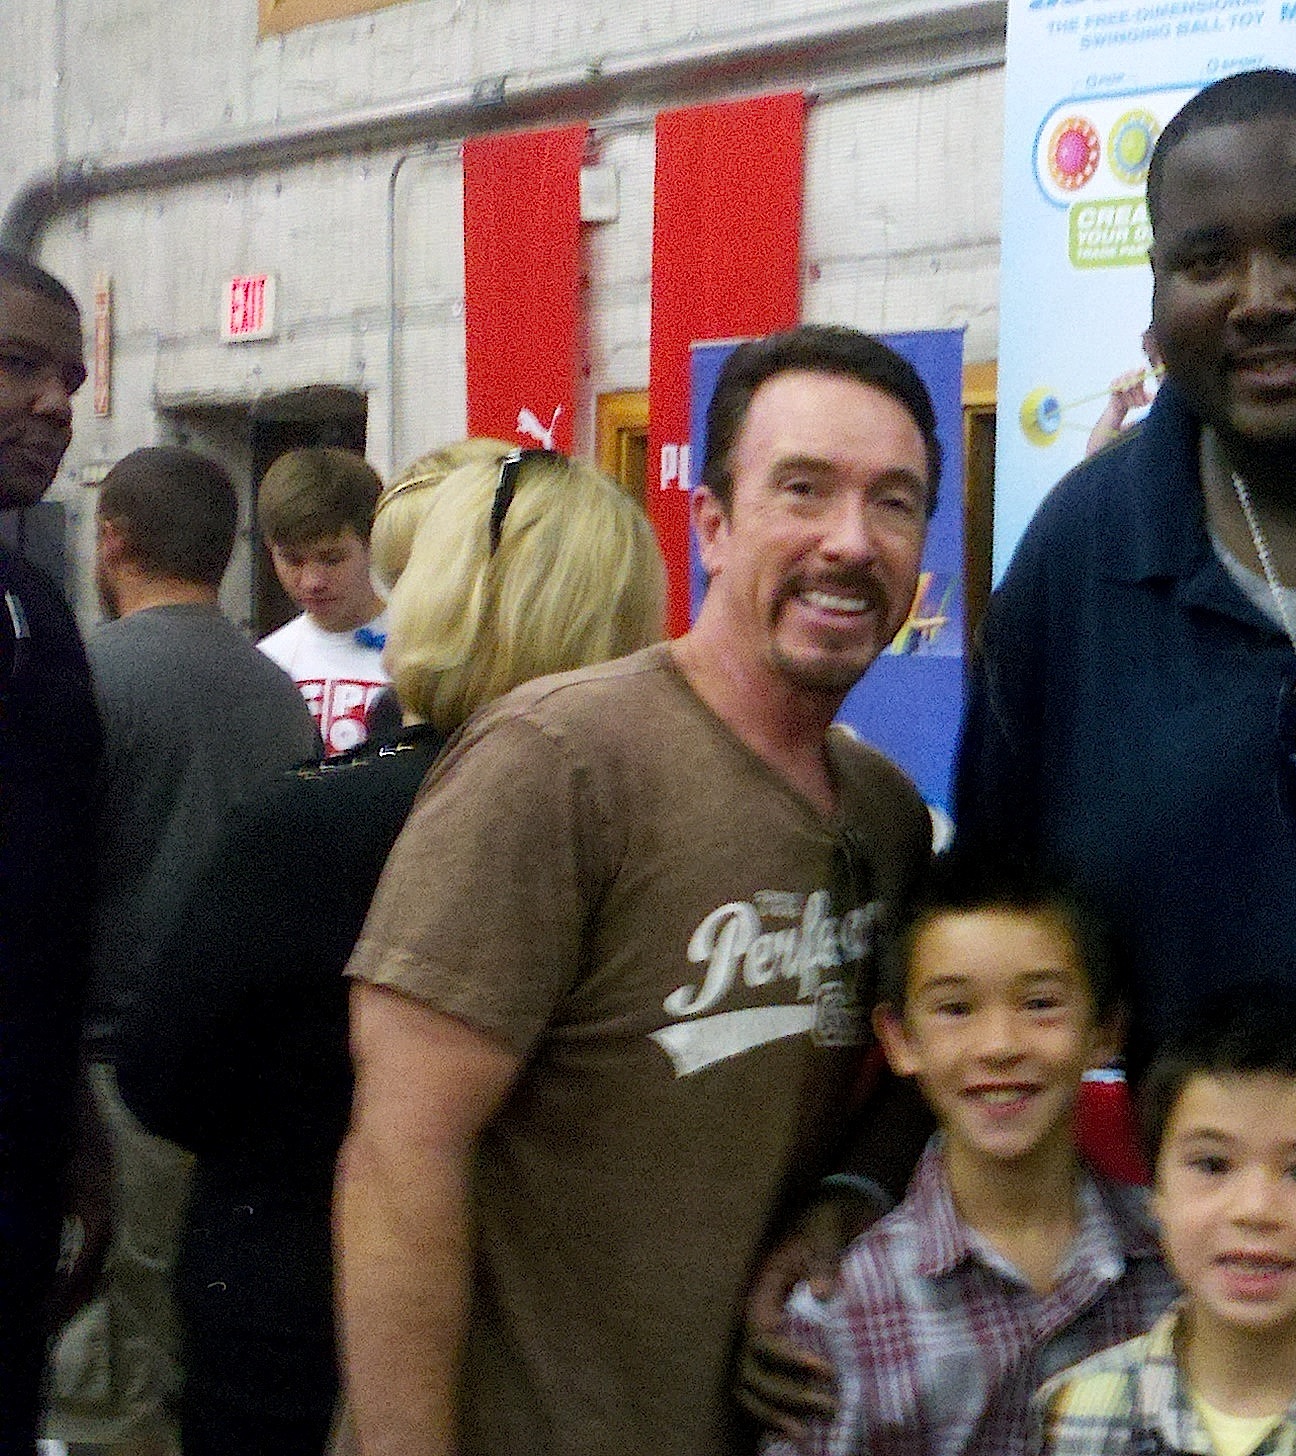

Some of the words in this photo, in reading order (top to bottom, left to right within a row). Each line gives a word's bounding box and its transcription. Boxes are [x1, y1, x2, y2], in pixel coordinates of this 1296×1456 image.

[1046, 17, 1079, 34] THE
[1080, 23, 1171, 51] SWINGING
[1176, 19, 1223, 36] BALL
[1228, 10, 1265, 30] TOY
[230, 274, 268, 335] EXIT
